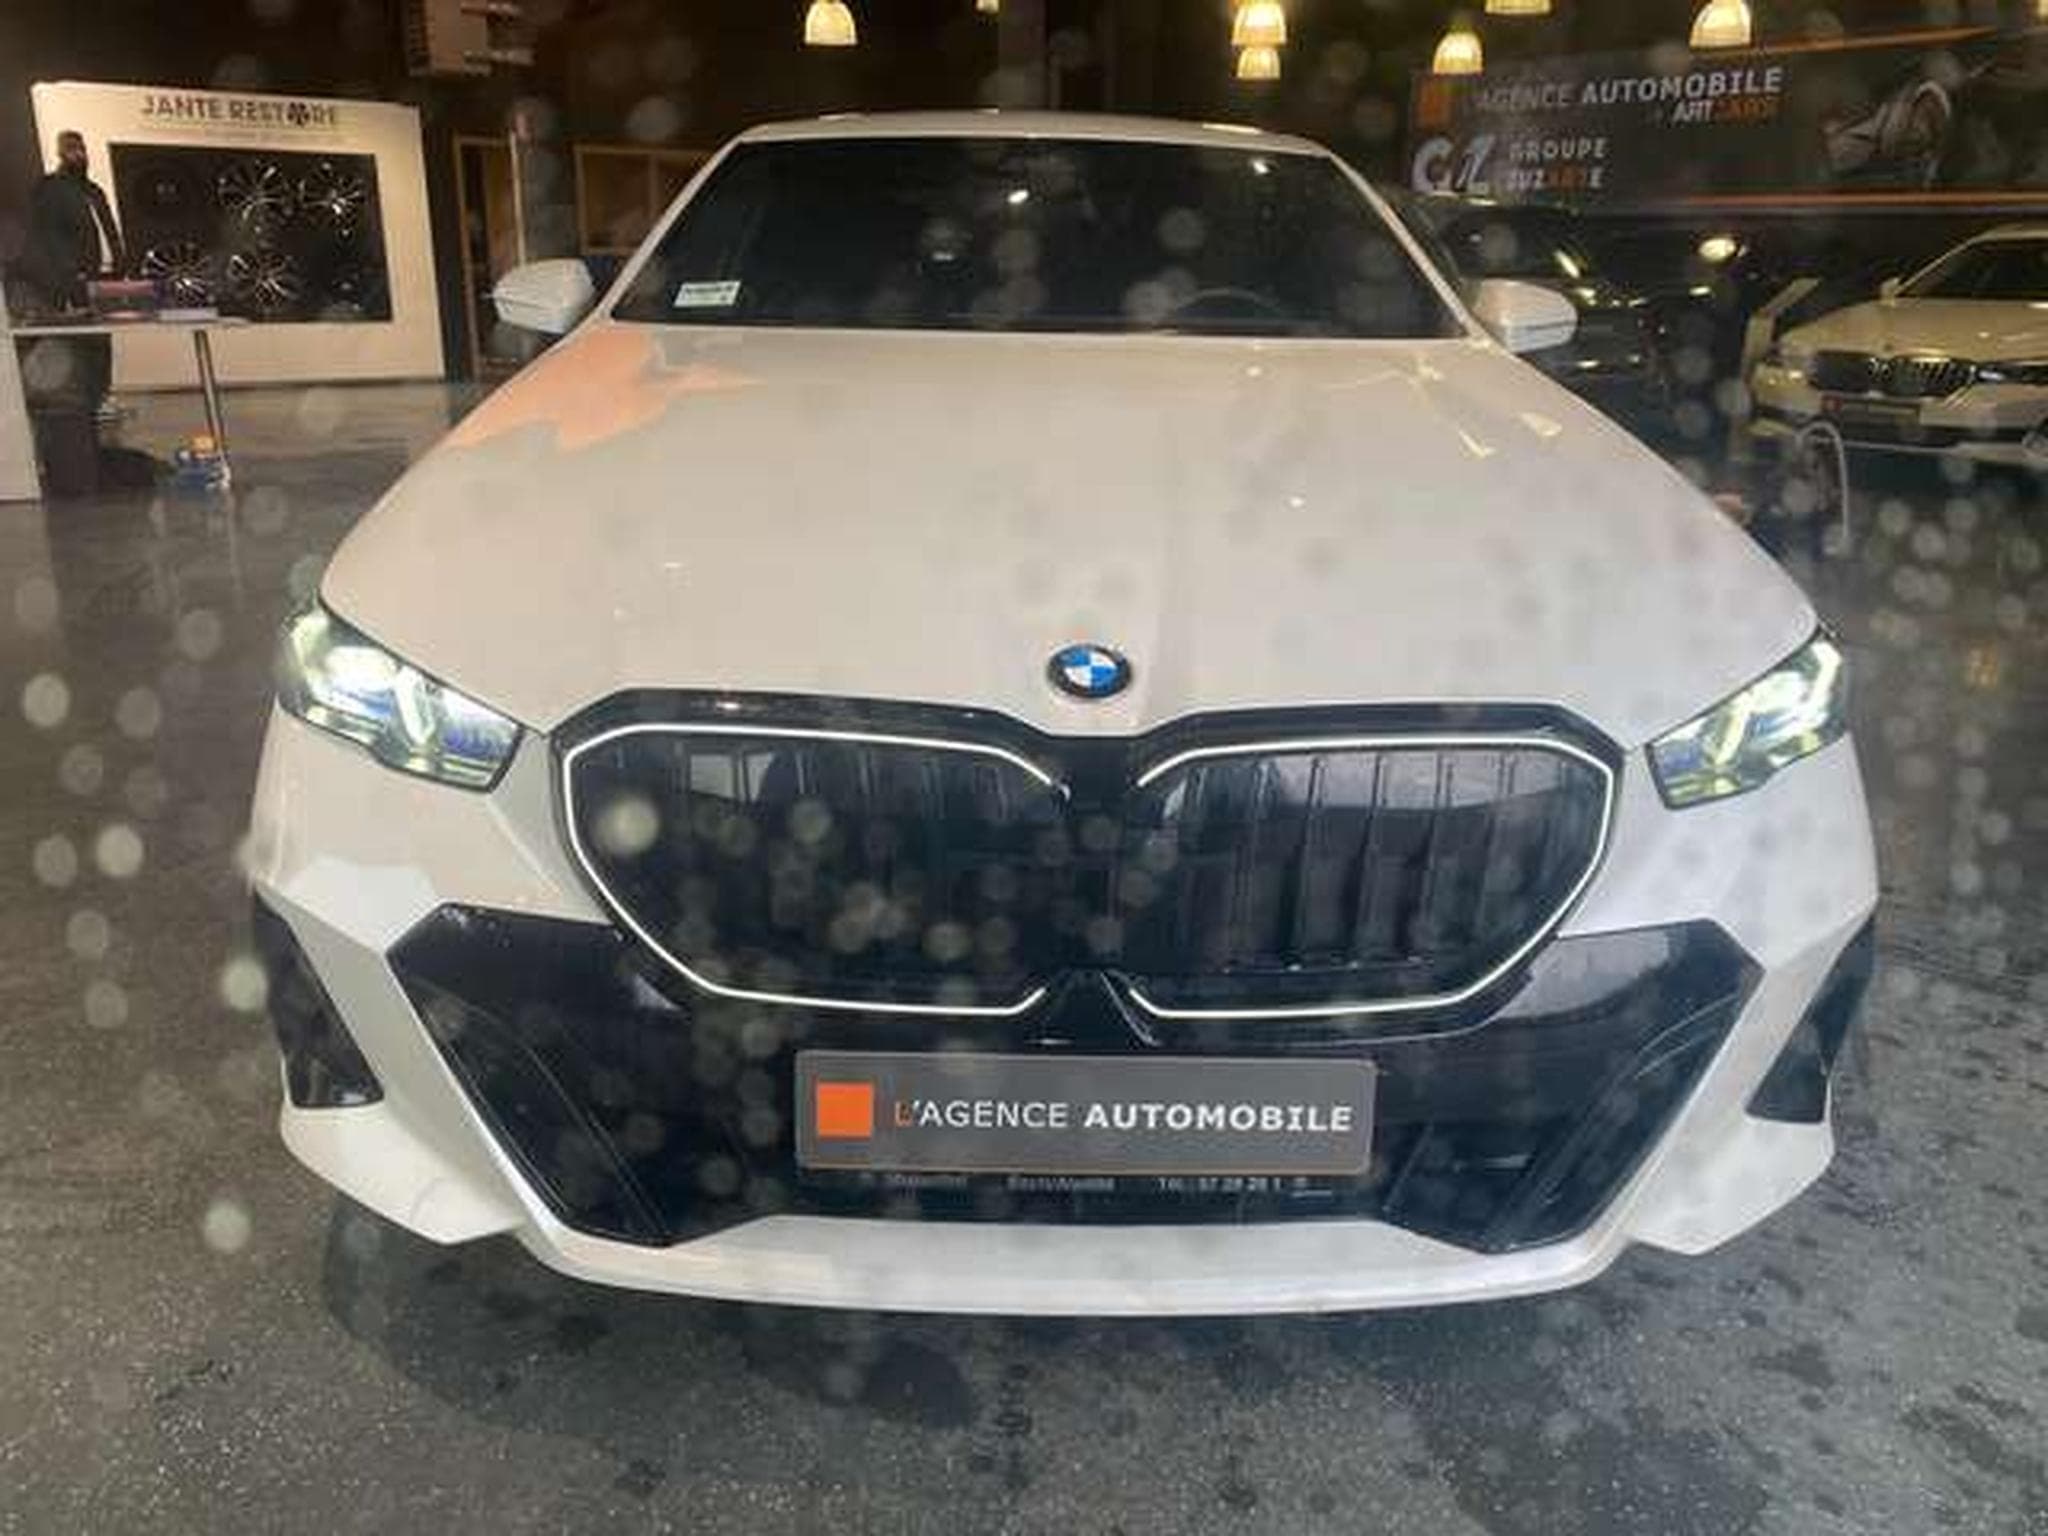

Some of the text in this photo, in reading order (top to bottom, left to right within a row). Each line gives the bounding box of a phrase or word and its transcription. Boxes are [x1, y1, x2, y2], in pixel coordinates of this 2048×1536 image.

[1582, 66, 1783, 104] AUTOMOBILE
[142, 94, 223, 119] JANTE
[894, 1099, 1354, 1132] L'AGENCE AUTOMOBILE
